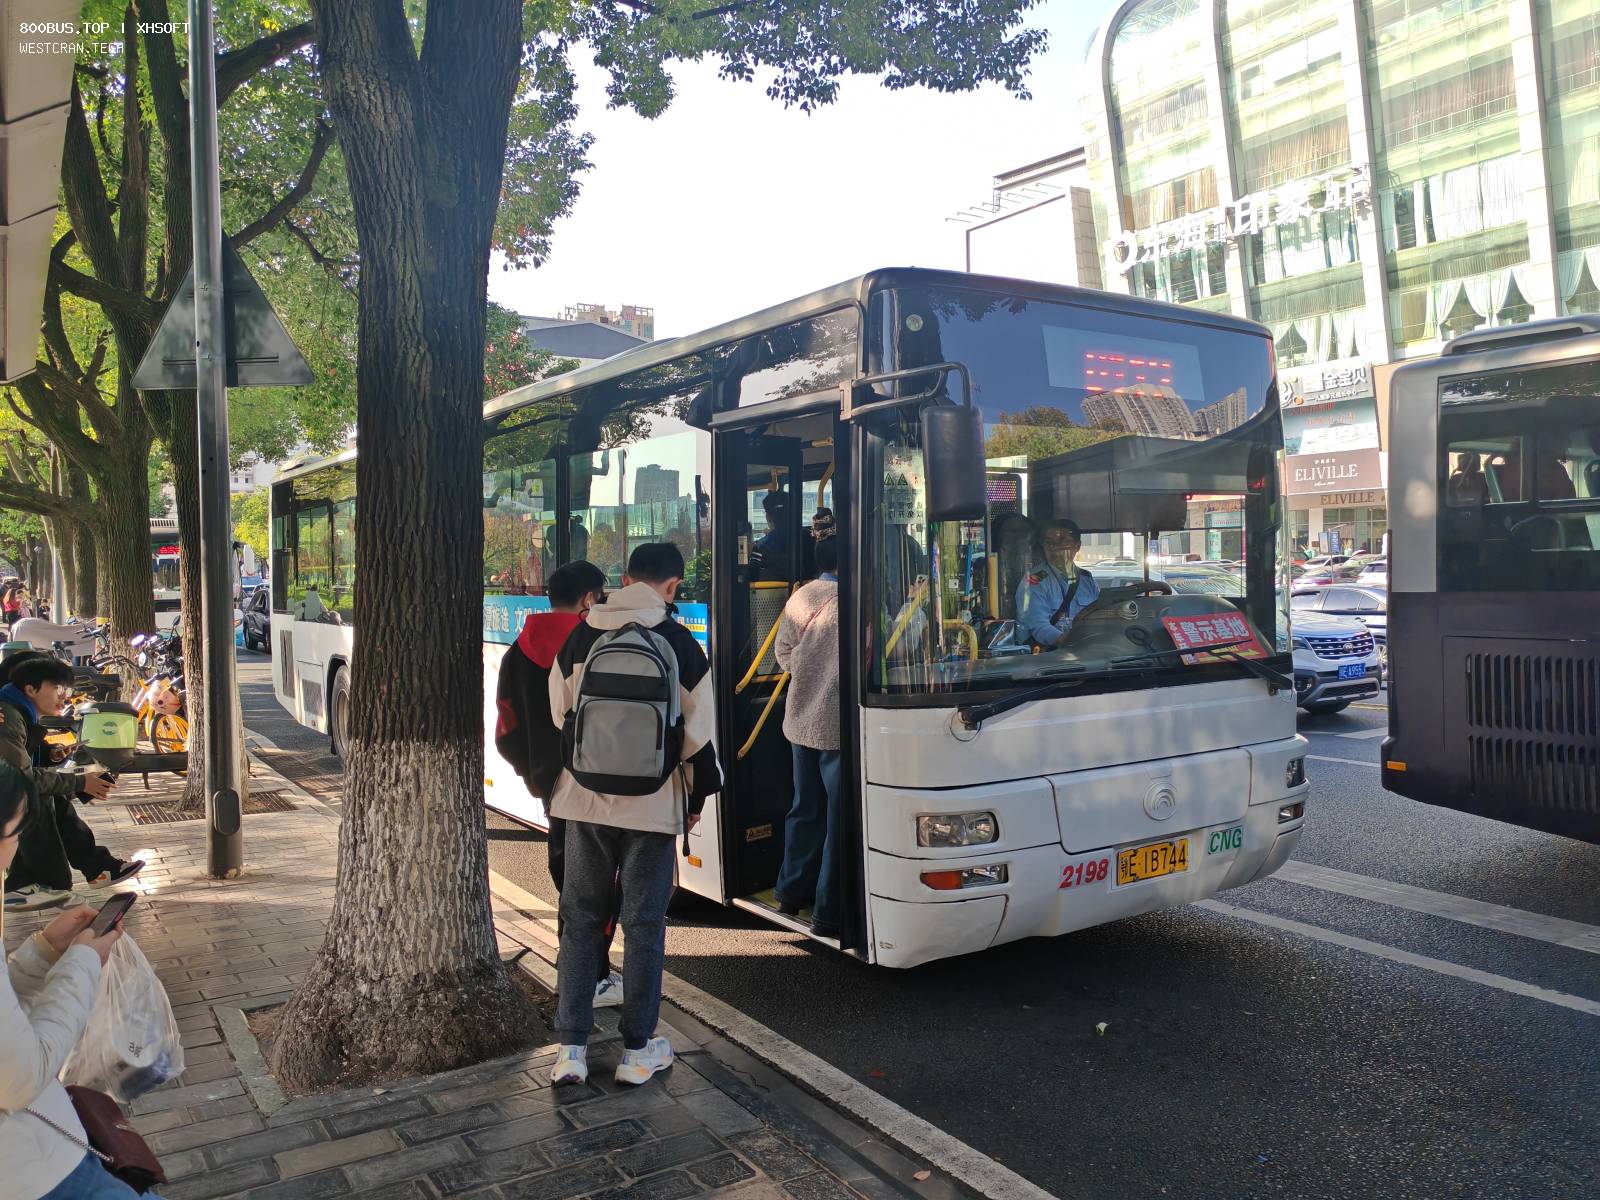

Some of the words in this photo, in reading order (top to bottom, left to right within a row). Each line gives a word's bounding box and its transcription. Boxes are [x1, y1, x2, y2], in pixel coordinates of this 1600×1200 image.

[1323, 366, 1367, 389] 金宝贝
[1295, 463, 1359, 482] ELIVILLE
[1320, 491, 1376, 506] ELIVILLE
[1179, 616, 1250, 644] 警示基地
[1209, 827, 1243, 854] CNG
[1058, 858, 1109, 889] 2198
